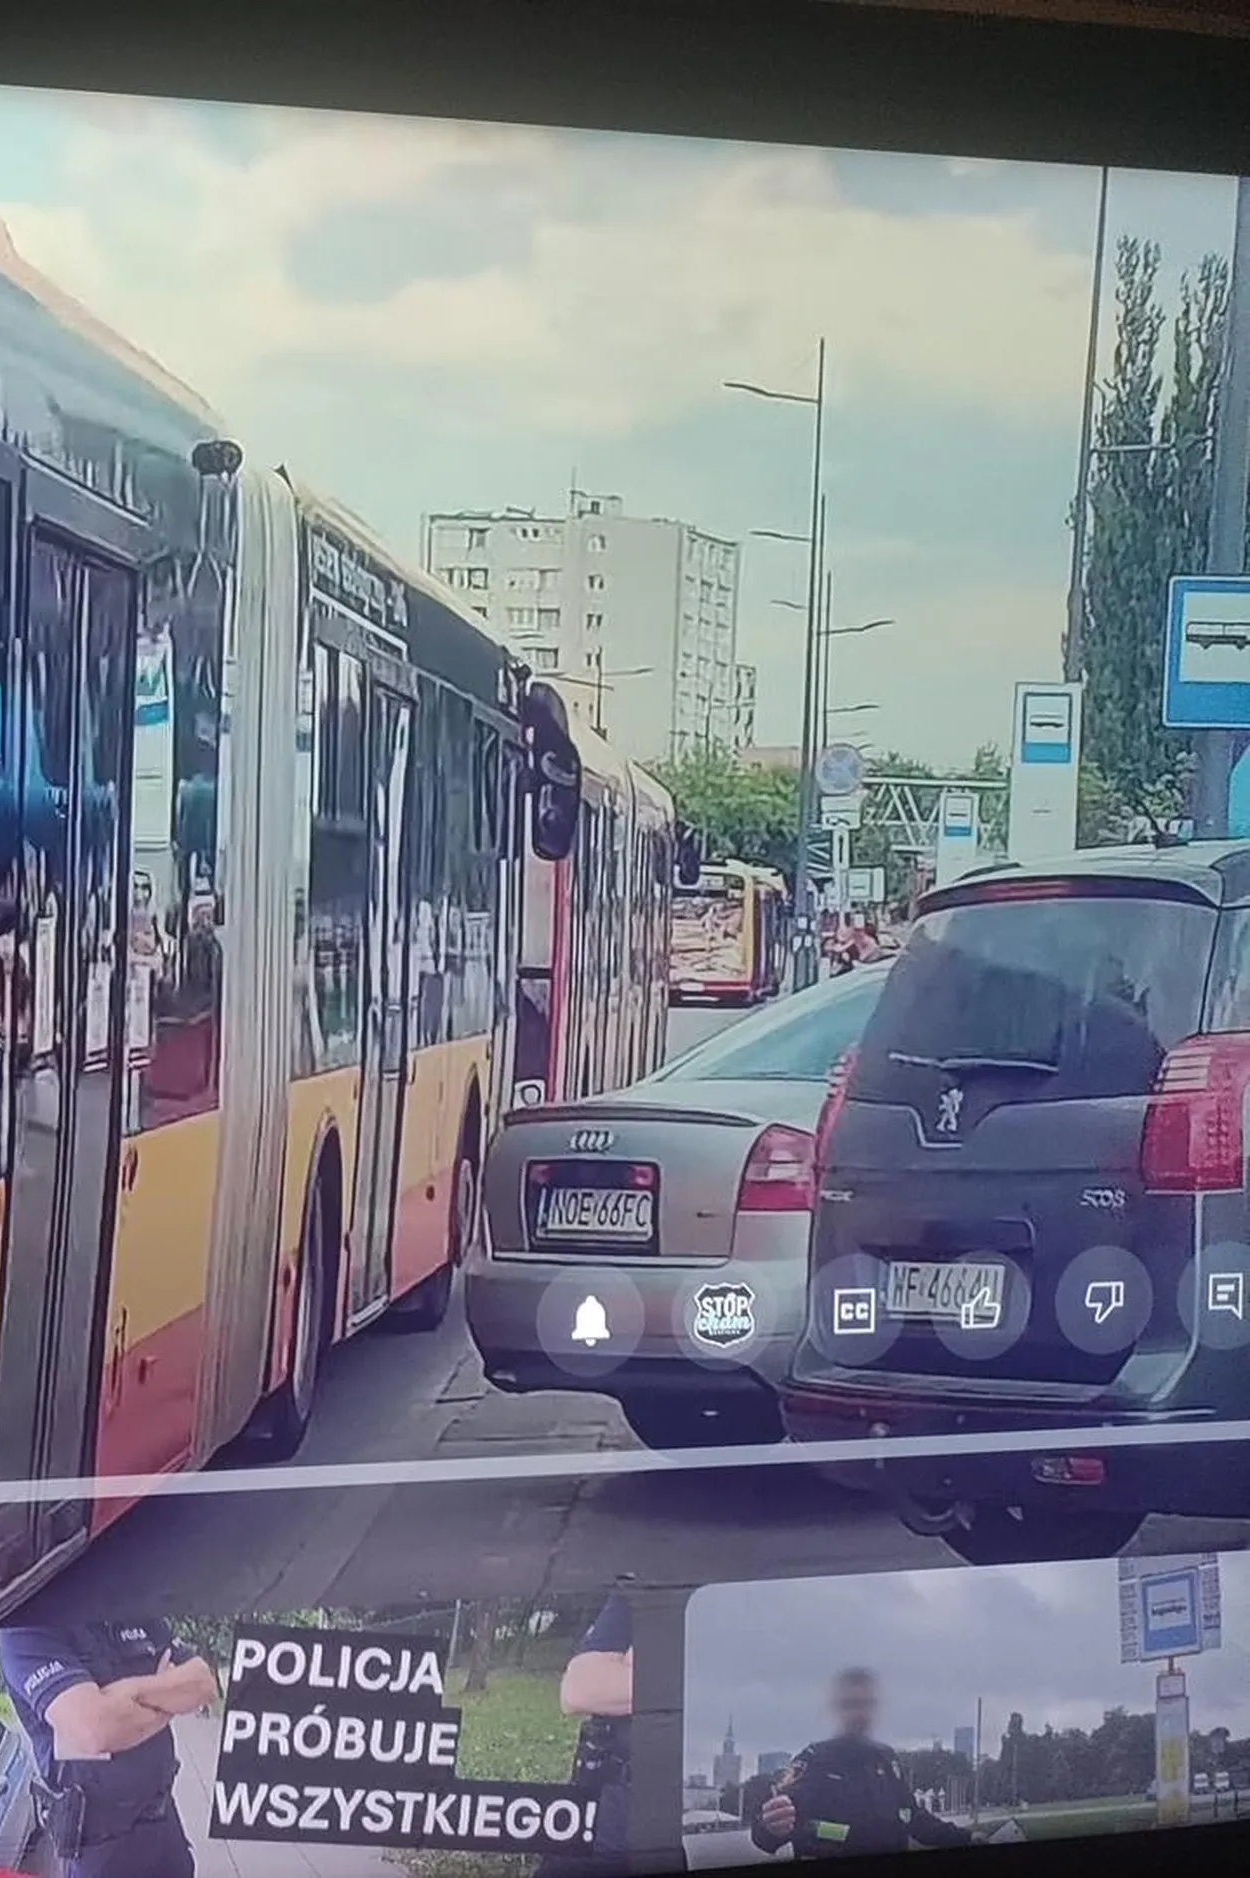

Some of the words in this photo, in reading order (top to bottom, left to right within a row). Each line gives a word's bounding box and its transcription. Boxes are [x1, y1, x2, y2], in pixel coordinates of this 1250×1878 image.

[701, 1293, 748, 1317] STOP
[232, 1638, 445, 1695] POLICJA
[222, 1703, 459, 1765] PRÓBUJE
[214, 1780, 599, 1843] WSZYSTKIEGO!
